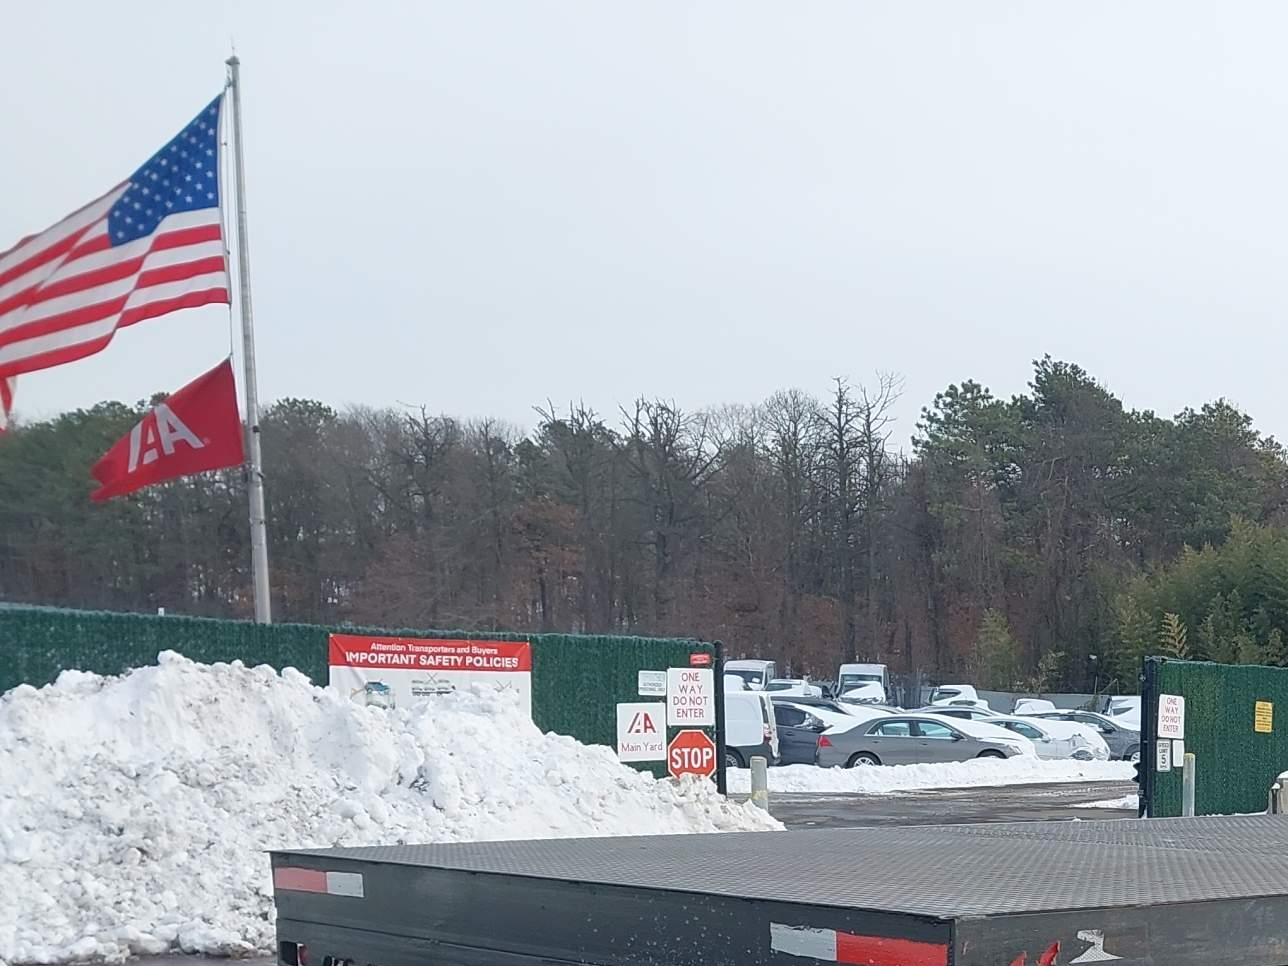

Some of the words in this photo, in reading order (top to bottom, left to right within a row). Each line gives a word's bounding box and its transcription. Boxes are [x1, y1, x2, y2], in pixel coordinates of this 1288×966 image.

[370, 642, 406, 652] Attention
[407, 643, 455, 655] Transporters
[456, 646, 470, 654] and
[471, 646, 498, 655] Buyers
[345, 652, 416, 665] IMPORTANT
[419, 654, 463, 667] SAFETY
[465, 655, 519, 668] POLICIES
[681, 672, 700, 682] ONE
[678, 685, 703, 694] WAY
[672, 696, 687, 706] DO
[688, 696, 708, 706] NOT
[1166, 697, 1177, 706] ONE
[676, 708, 704, 718] ENTER
[1164, 706, 1179, 714] WAY
[1170, 716, 1181, 724] NOT
[1163, 725, 1179, 733] ENTER
[621, 742, 641, 752] Main
[642, 742, 663, 752] Yard
[671, 747, 713, 769] STOP
[1161, 754, 1167, 764] 5
